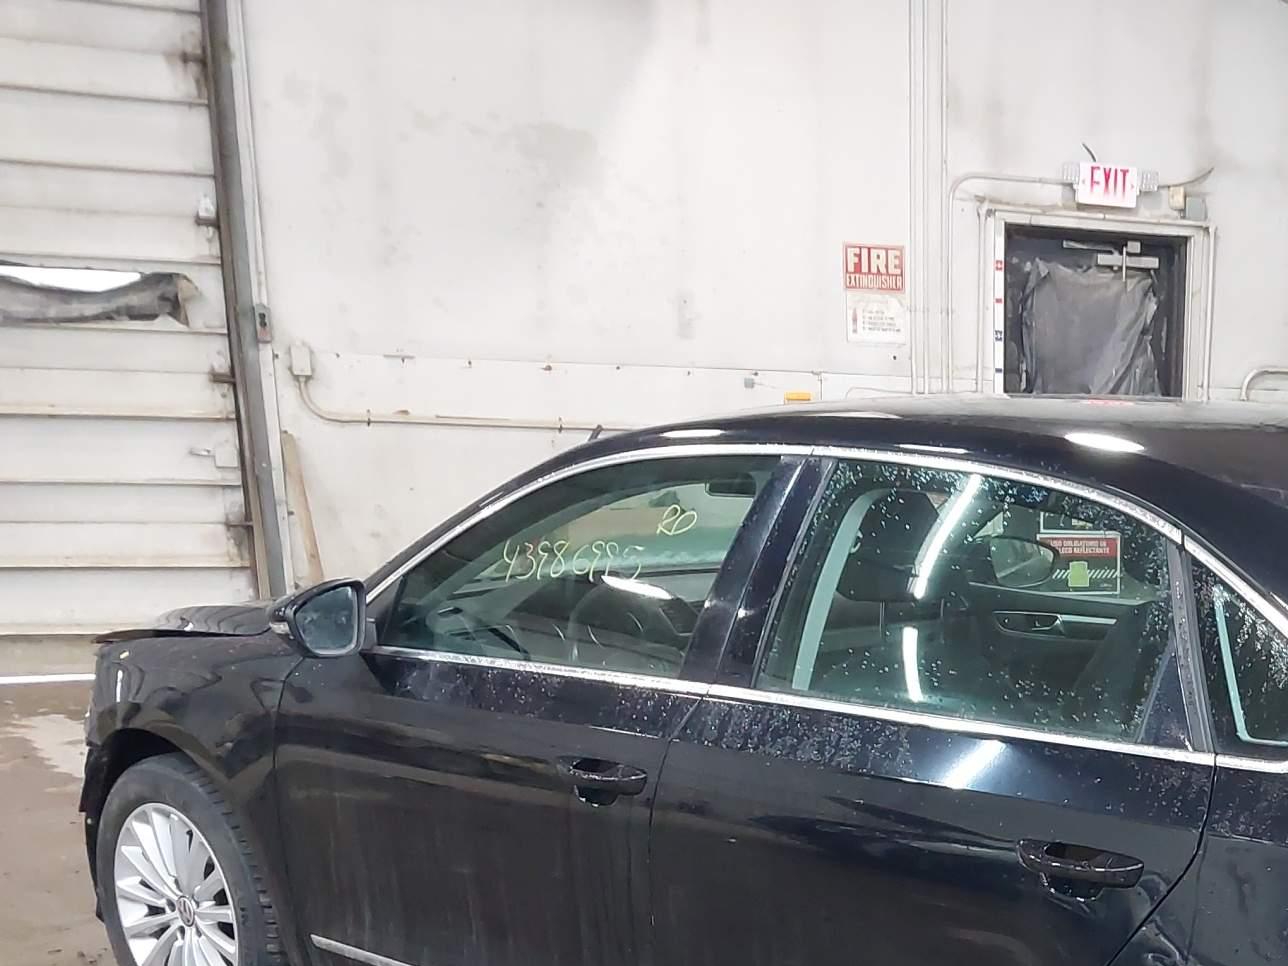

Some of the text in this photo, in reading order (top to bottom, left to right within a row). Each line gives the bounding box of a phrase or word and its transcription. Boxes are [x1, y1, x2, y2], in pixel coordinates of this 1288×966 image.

[1090, 165, 1129, 197] EXIT
[847, 247, 902, 275] FIRE
[846, 273, 903, 289] EXTINGUISHER
[503, 537, 644, 583] 43986995
